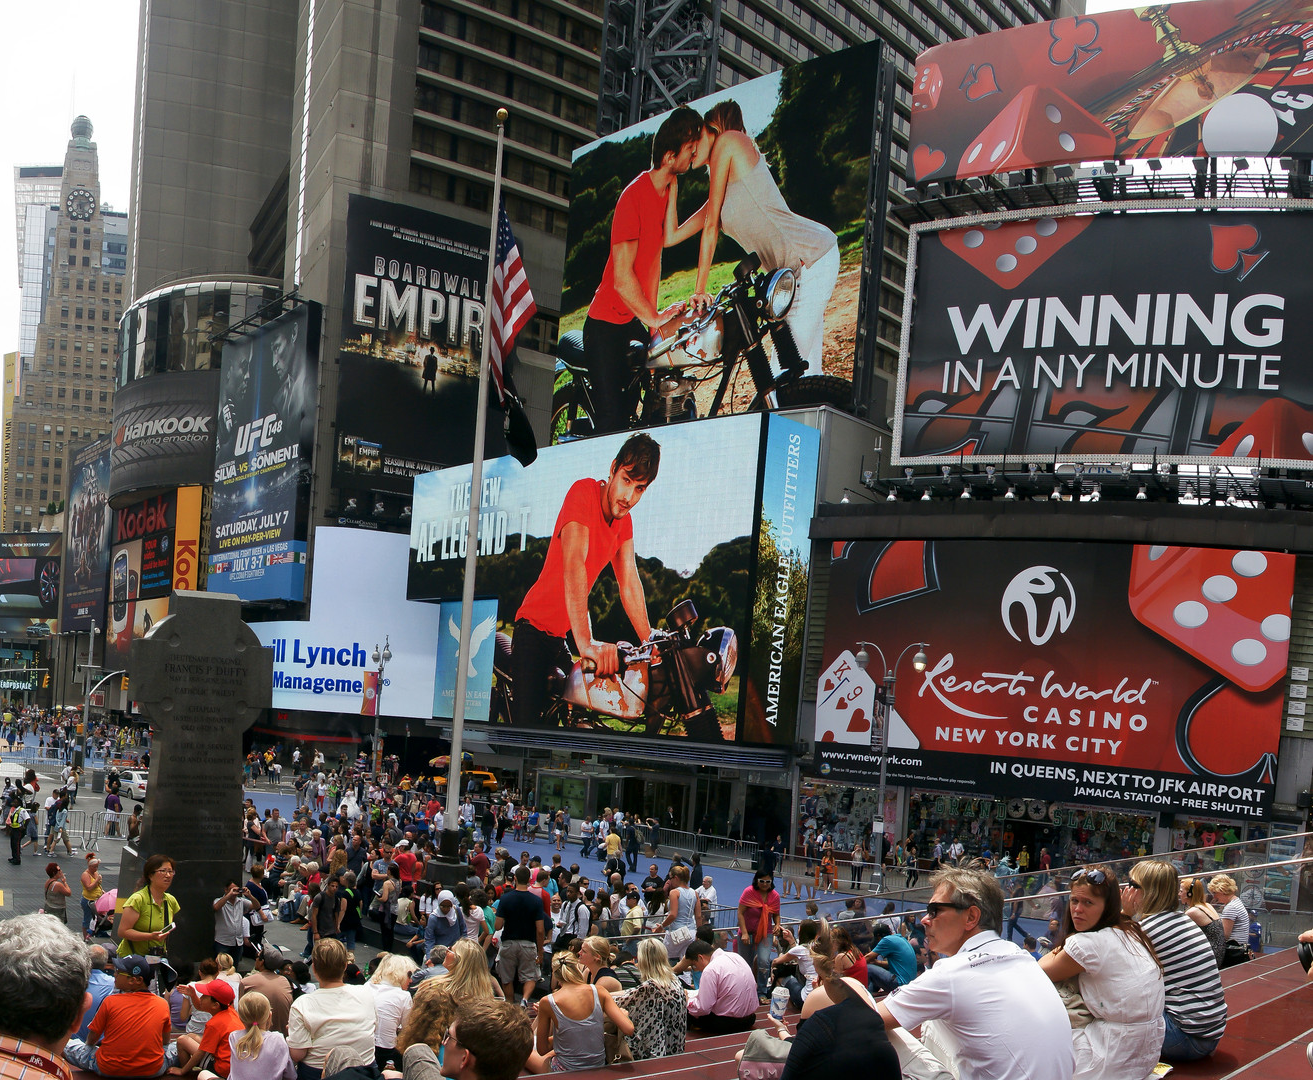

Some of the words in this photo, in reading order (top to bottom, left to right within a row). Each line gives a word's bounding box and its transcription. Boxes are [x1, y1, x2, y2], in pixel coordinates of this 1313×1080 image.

[374, 256, 486, 300] BOARDWAL
[947, 294, 1285, 355] WINNING
[942, 359, 983, 394] IN
[992, 357, 1020, 390] A
[1106, 354, 1281, 391] MINUTE
[133, 436, 160, 448] driving
[163, 434, 208, 443] emotion
[234, 414, 276, 456] UFC
[268, 420, 283, 436] 148
[214, 465, 237, 482] SILVA
[251, 446, 291, 472] SONNEN
[235, 471, 260, 482] MIDDLEWEIGHT
[260, 462, 286, 474] CHAMPIONSHIP
[385, 457, 404, 467] SEASON
[406, 461, 415, 469] ONE
[451, 482, 472, 512] THE
[480, 477, 501, 508] EW
[782, 432, 801, 552] OUTFITTERS
[118, 495, 169, 542] Kodak
[216, 518, 258, 538] SATURDAY,
[259, 512, 282, 529] JULY
[283, 511, 289, 524] 7
[219, 539, 231, 548] LIVE
[241, 528, 281, 545] PAY-PER-VIEW
[416, 521, 437, 562] AE
[520, 507, 531, 551] T
[213, 552, 240, 562] INTERNATIONAL
[252, 548, 262, 556] WEEK
[275, 543, 288, 552] VEGAS
[232, 558, 250, 572] JULY
[251, 555, 264, 569] 3-7
[774, 556, 791, 622] EAGLE
[293, 639, 366, 668] Lynch
[165, 663, 204, 674] FRANCIS
[216, 668, 248, 677] DUFFY
[273, 671, 365, 694] Manageme
[765, 622, 786, 727] AMERICAN
[918, 653, 1034, 719] Resorts
[1041, 670, 1151, 704] World
[1023, 706, 1147, 731] CASINO
[936, 727, 986, 743] NEW
[995, 731, 1056, 749] YORK
[1066, 737, 1122, 755] CITY
[822, 751, 922, 766] www.rwnewyrk.com
[990, 761, 1006, 774] IN
[1011, 764, 1079, 784] QUEENS,
[1083, 770, 1129, 787] NEXT
[1133, 775, 1155, 790] TO
[1158, 779, 1185, 794] JFK
[1188, 782, 1265, 803] AIRPORT
[936, 798, 1006, 820] GRAND
[1053, 810, 1116, 832] SLAM
[1074, 787, 1121, 800] JAMAICA
[1123, 791, 1170, 804] STATION
[1182, 798, 1208, 809] FREE
[1211, 802, 1263, 816] SHUTTLE
